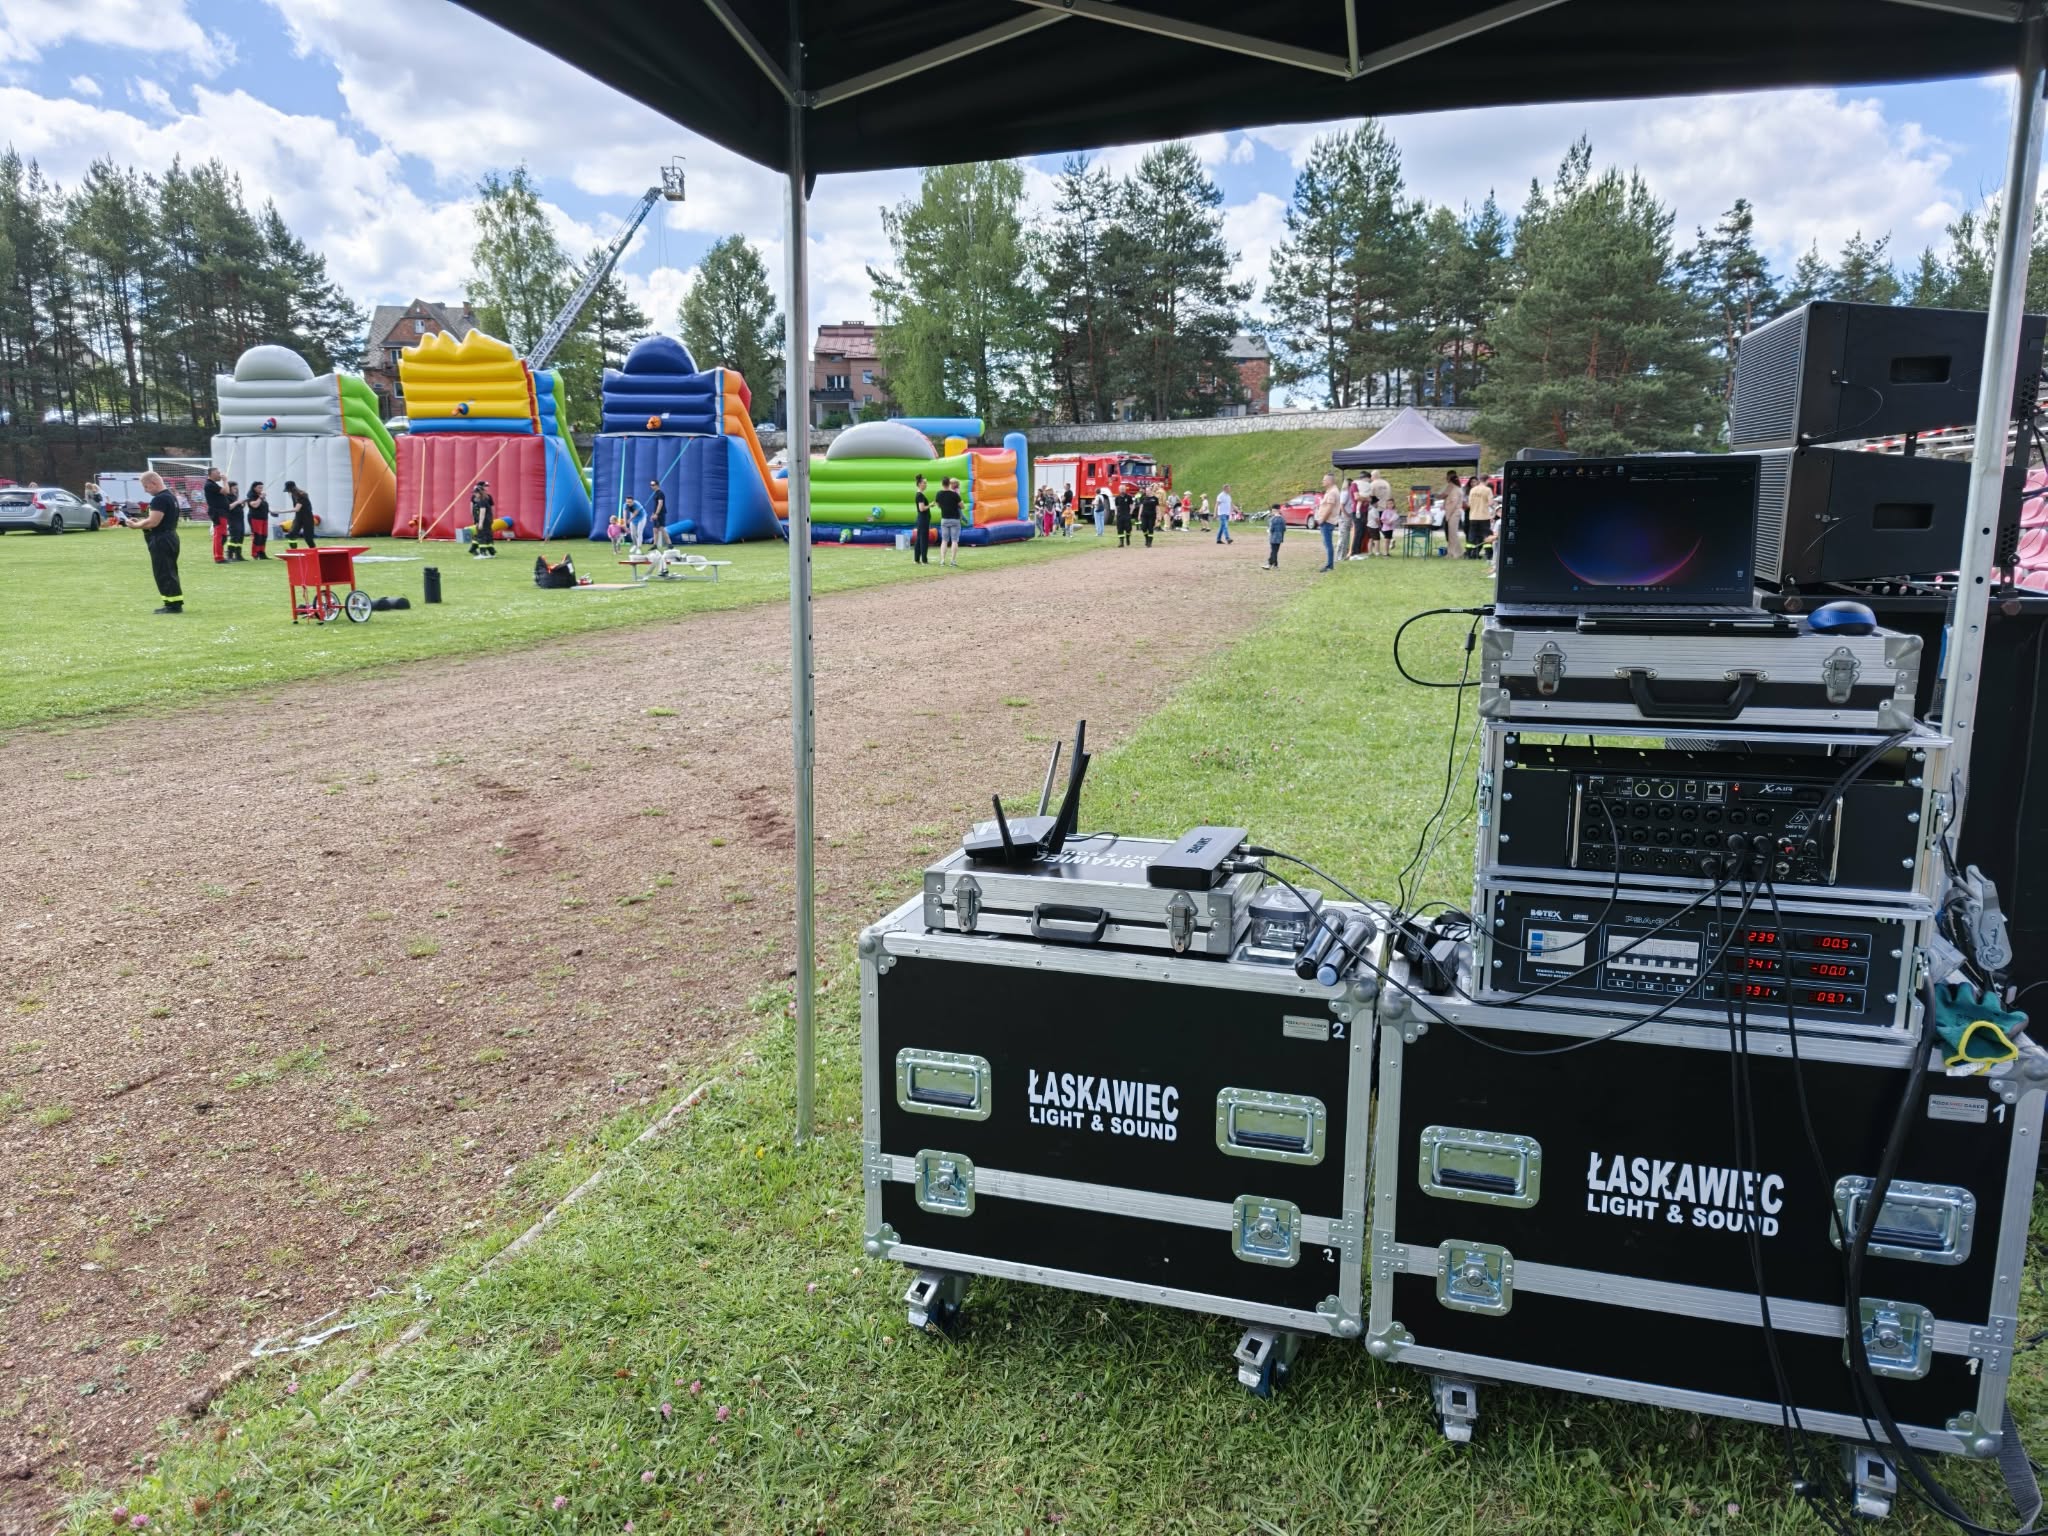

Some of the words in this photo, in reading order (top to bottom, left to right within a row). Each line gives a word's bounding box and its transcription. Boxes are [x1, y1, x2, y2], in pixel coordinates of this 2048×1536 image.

[1032, 850, 1151, 869] ASKAWIEC
[1530, 909, 1562, 921] BOTEX
[1747, 931, 1775, 943] 239
[1332, 1022, 1346, 1039] 2
[1028, 1069, 1179, 1122] ŁASKAWIEC
[1993, 1104, 2006, 1123] 1
[1029, 1106, 1085, 1129] LIGHT
[1091, 1114, 1104, 1132] &
[1110, 1116, 1178, 1141] SOUND
[1587, 1151, 1785, 1215] ŁASKAWIEC
[1587, 1193, 1660, 1220] LIGHT
[1666, 1203, 1684, 1224] &
[1323, 1248, 1335, 1263] 2
